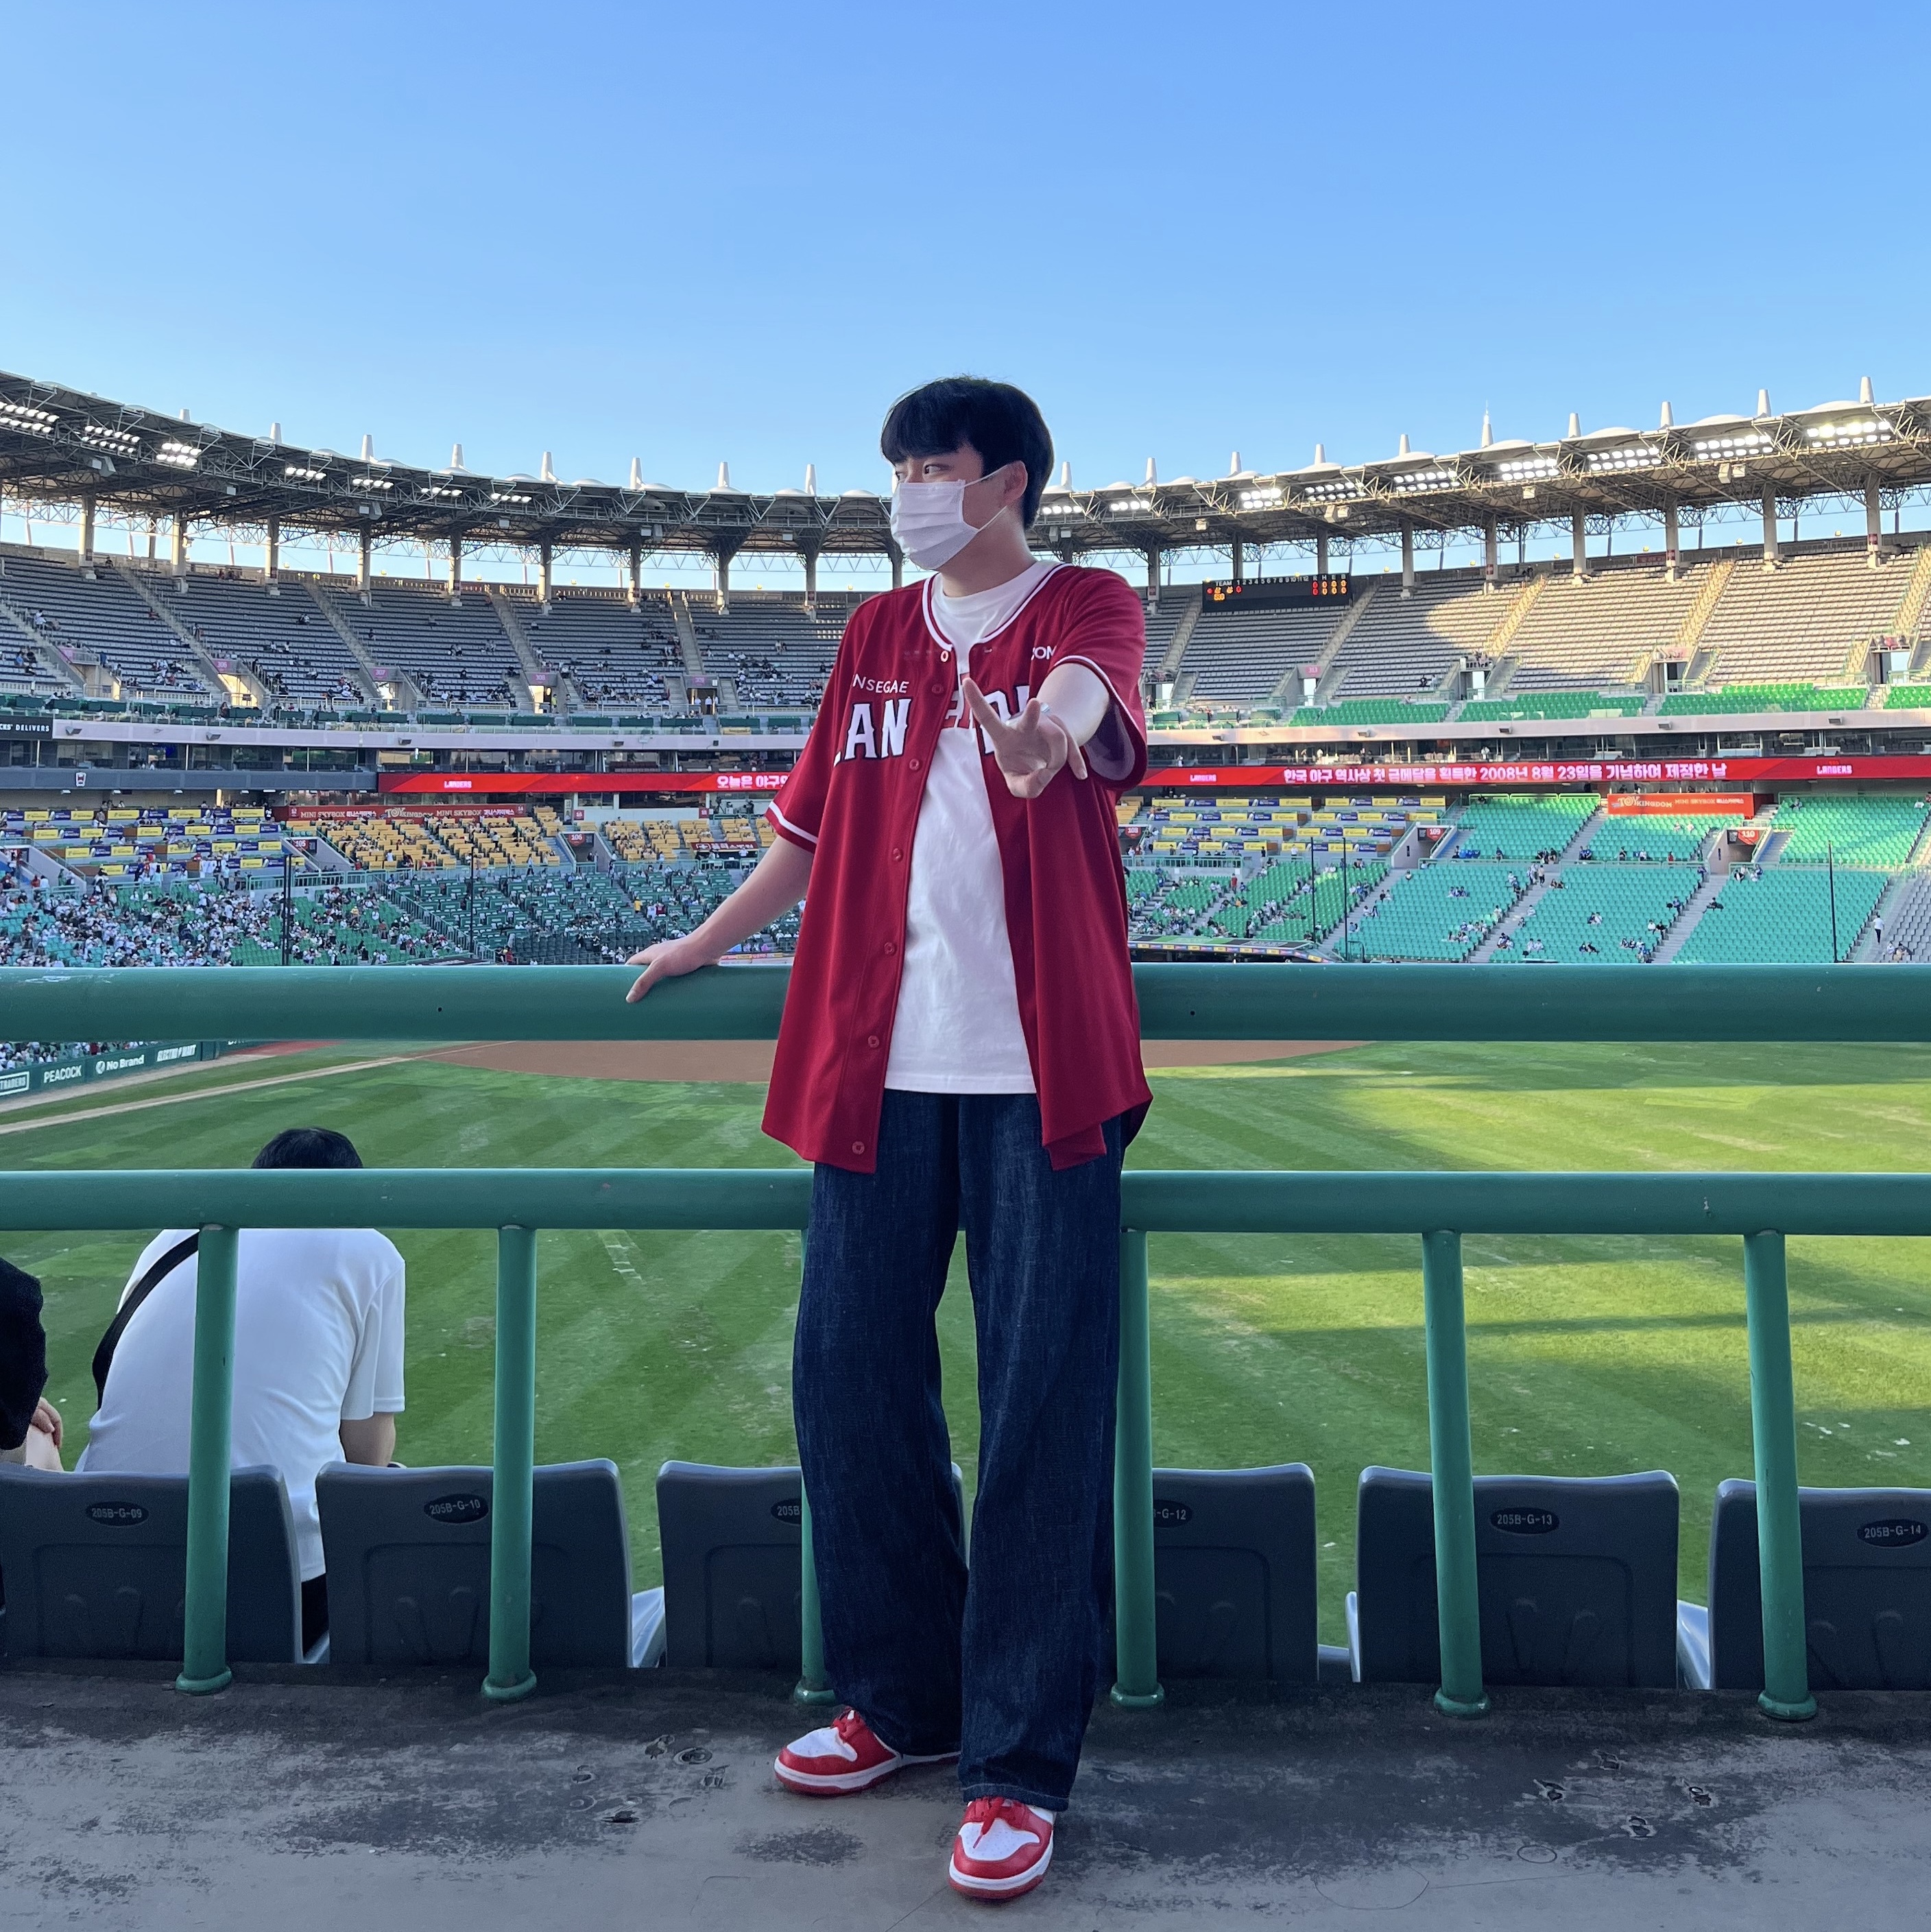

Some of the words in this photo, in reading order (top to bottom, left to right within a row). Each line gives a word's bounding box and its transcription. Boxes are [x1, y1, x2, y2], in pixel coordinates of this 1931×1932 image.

[852, 673, 909, 693] NSEGAE
[15, 724, 50, 732] DELIVERS
[835, 698, 911, 766] AN
[1284, 769, 1307, 783] 한국
[1309, 769, 1332, 783] 야구
[1335, 768, 1371, 783] 역사상
[1373, 767, 1386, 783] 첫
[1388, 767, 1436, 782] 금메달을
[1439, 766, 1477, 781] 획득한
[1480, 765, 1528, 780] 2008년
[1532, 765, 1554, 780] 8월
[1557, 765, 1603, 780] 23일을
[1606, 763, 1662, 779] 기념하여
[1665, 763, 1709, 779] 제정한
[1712, 763, 1727, 779] 날
[1816, 765, 1852, 774] LANDERS
[717, 775, 753, 789] 오늘은
[106, 1060, 119, 1071] No
[119, 1054, 145, 1069] Brand
[43, 1065, 82, 1083] PEACOCK
[92, 1507, 142, 1518] 205B-G-09
[429, 1499, 481, 1515] 205B-G-10
[1497, 1514, 1552, 1525] 205B-G-13
[1864, 1525, 1921, 1538] 205B-G-14
